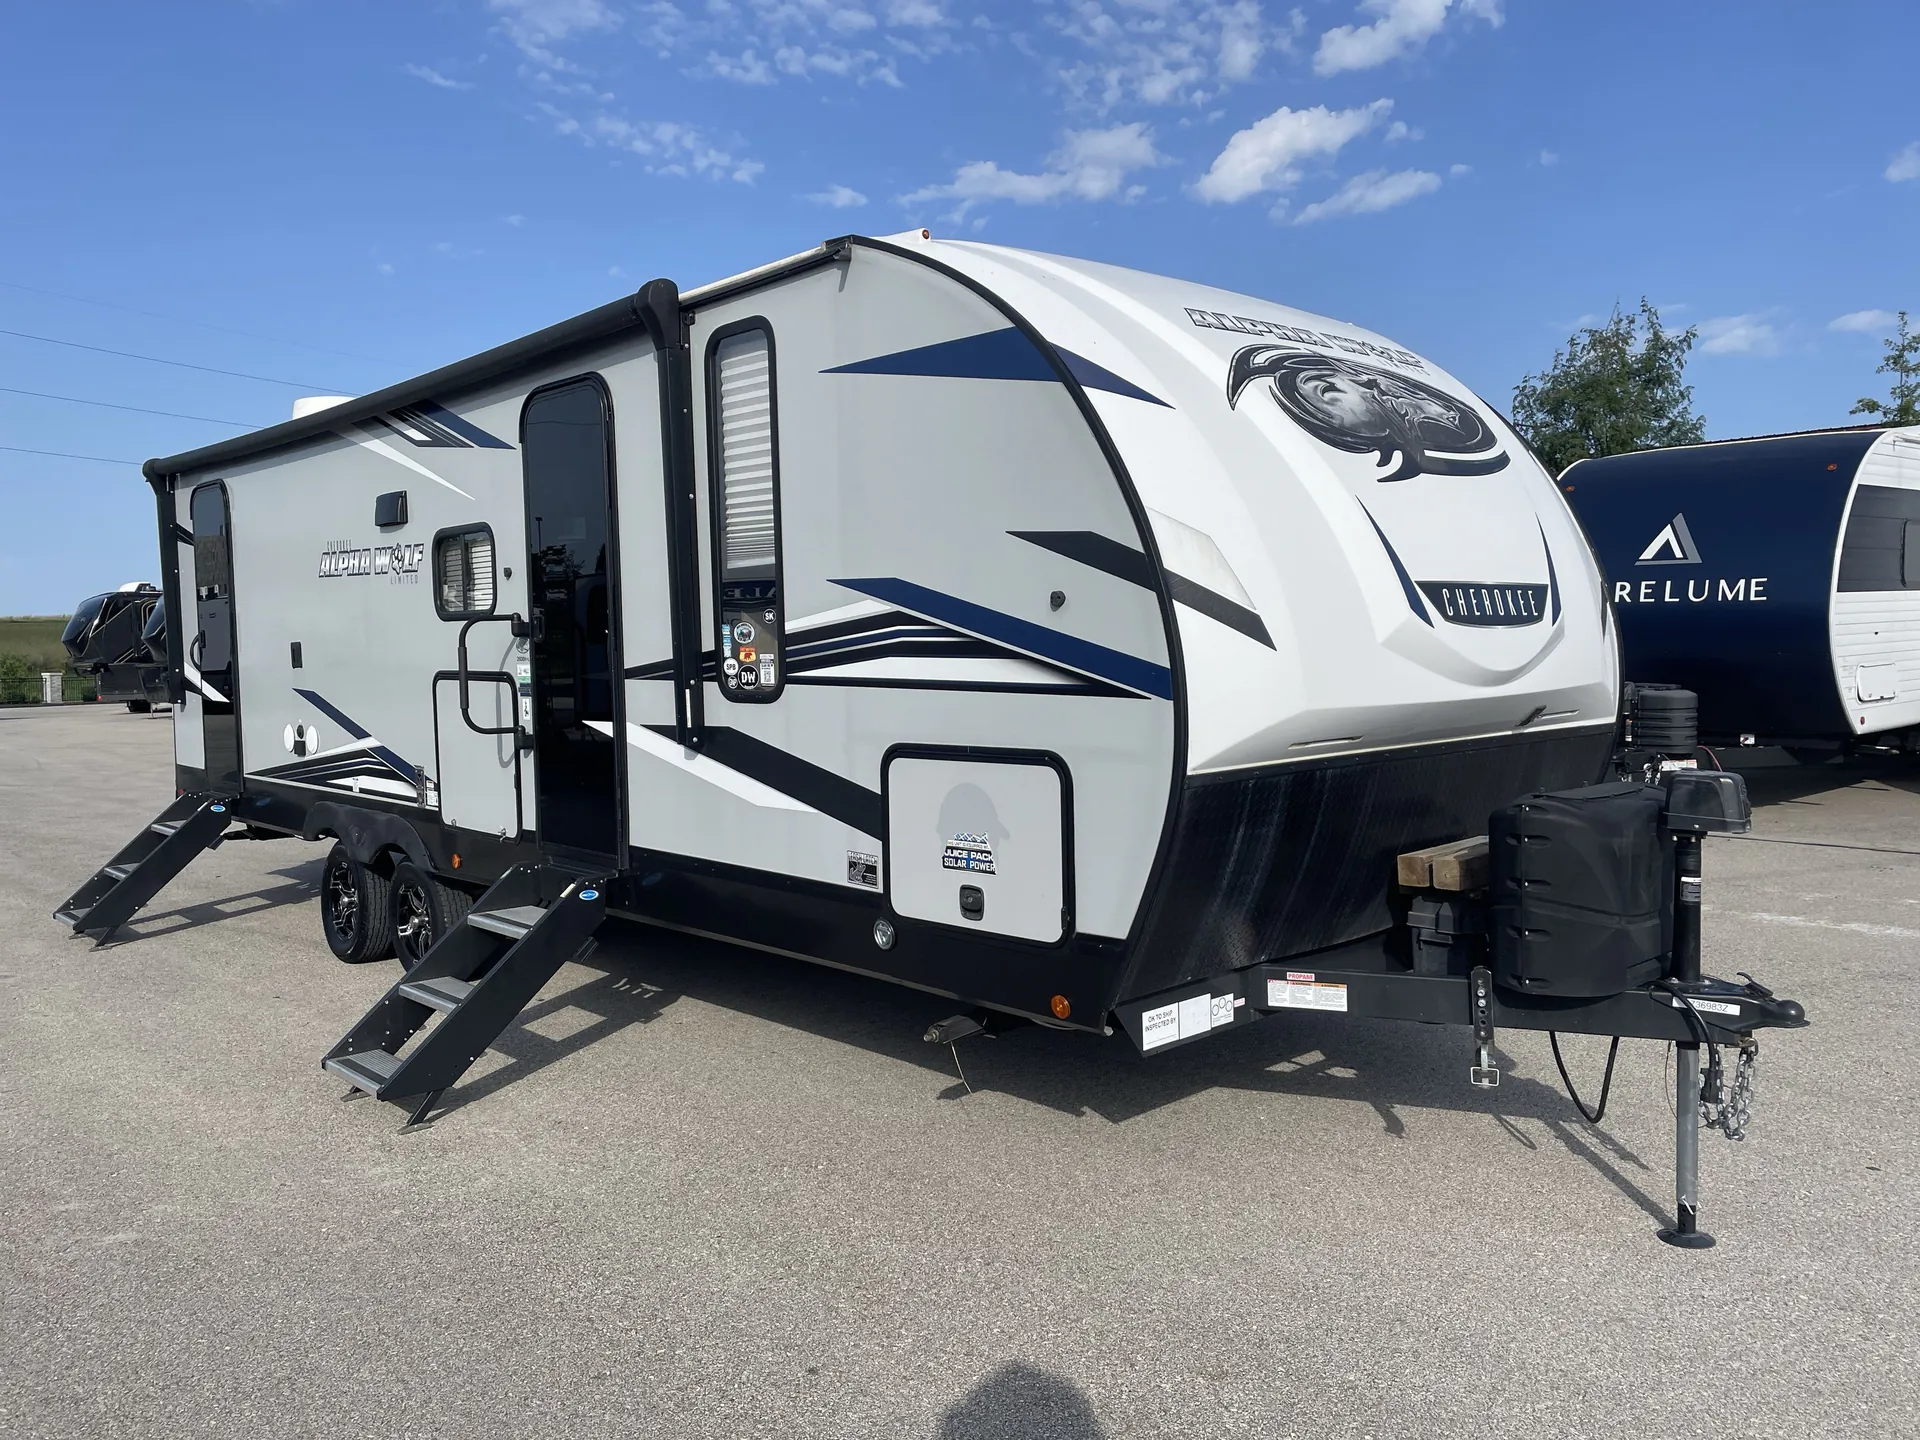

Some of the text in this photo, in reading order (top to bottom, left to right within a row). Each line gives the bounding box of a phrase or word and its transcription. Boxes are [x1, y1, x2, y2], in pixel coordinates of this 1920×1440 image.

[1184, 308, 1333, 348] ALPHA
[319, 548, 371, 578] ALPHA
[1614, 577, 1768, 603] RELUME
[1442, 588, 1539, 617] CHEROKEE
[741, 671, 756, 683] DW
[944, 848, 994, 862] JUICE PACK
[944, 857, 996, 872] SOLAR POWER
[1287, 973, 1314, 981] PROPANE
[1147, 1009, 1173, 1023] OK TO SHIP
[1145, 1017, 1177, 1032] INSPECTED BY
